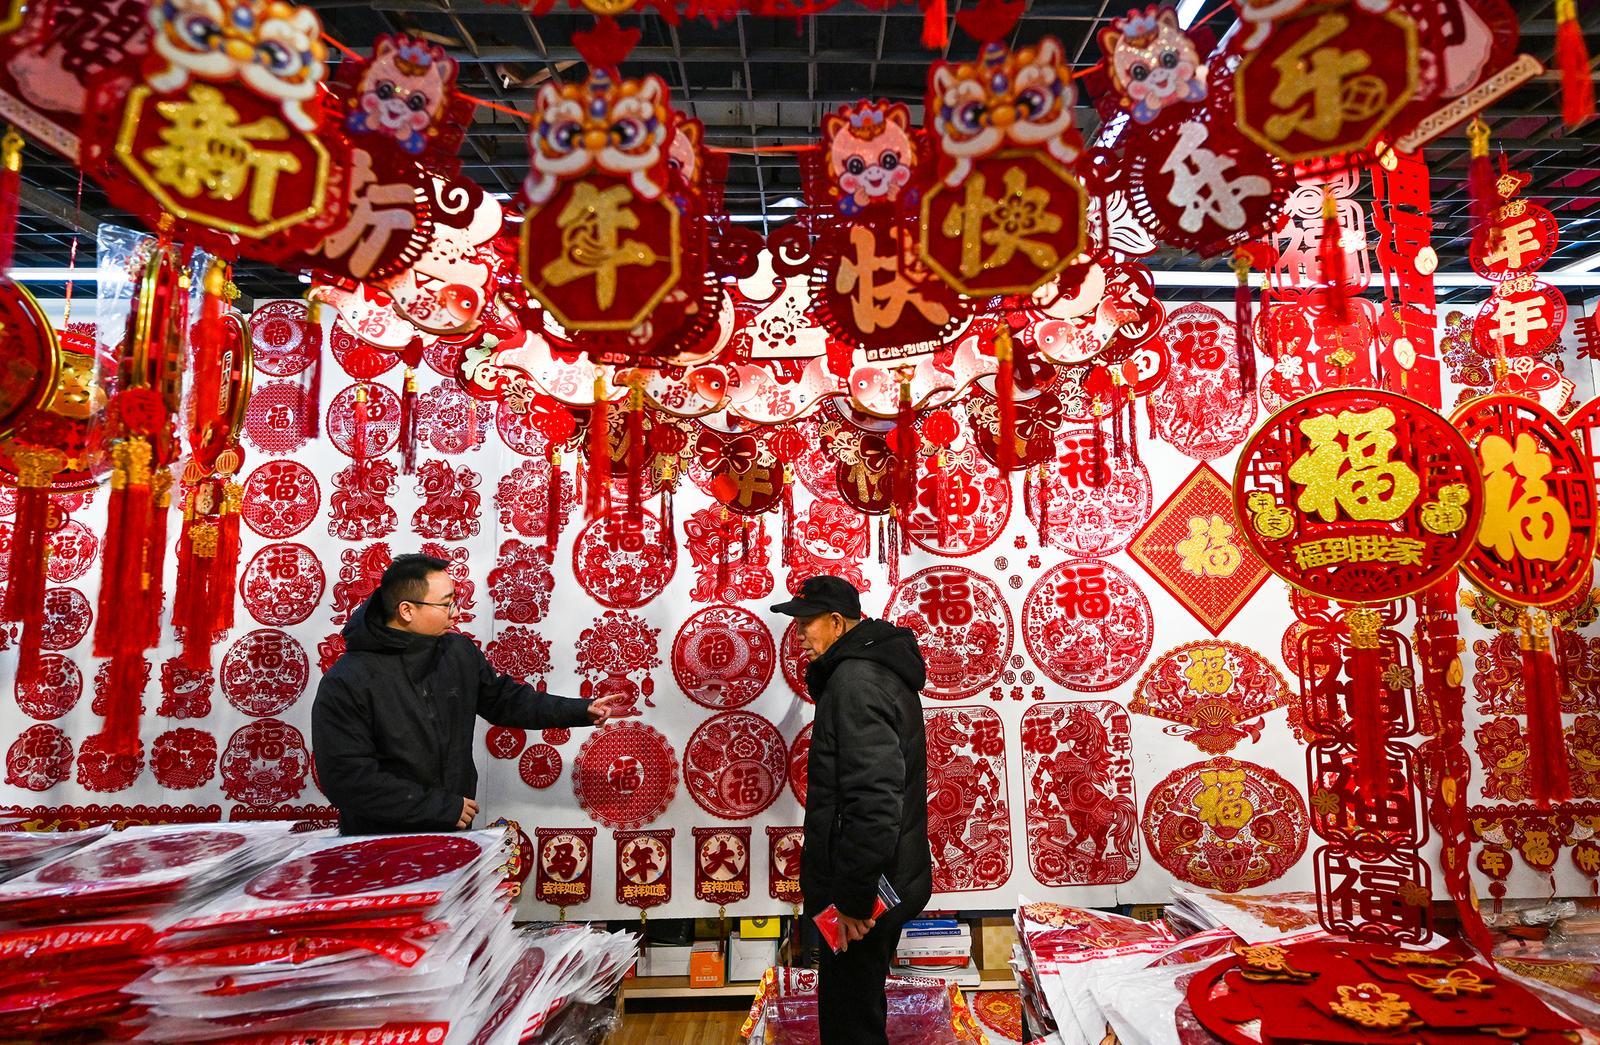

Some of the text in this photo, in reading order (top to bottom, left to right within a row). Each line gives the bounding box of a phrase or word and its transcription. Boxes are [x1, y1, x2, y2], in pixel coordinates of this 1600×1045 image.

[1263, 14, 1388, 141] 乐
[143, 84, 300, 221] 新
[1160, 121, 1271, 233] 乐
[942, 167, 1064, 278] 快
[542, 181, 659, 308] 年
[1483, 218, 1541, 269] 年
[835, 225, 950, 334] 快
[358, 309, 387, 337] 福
[407, 296, 432, 320] 福
[1489, 296, 1548, 345] 年
[264, 319, 292, 346] 福
[1078, 330, 1101, 354] 福
[1172, 320, 1228, 371] 福
[549, 367, 579, 396] 福
[661, 383, 689, 409] 福
[268, 406, 290, 430] 福
[757, 385, 796, 417] 福
[1059, 439, 1112, 488] 福
[1288, 407, 1420, 523] 福
[263, 464, 300, 501] 福
[1477, 433, 1571, 562] 福
[54, 536, 77, 560] 福
[603, 514, 646, 553] 福
[1176, 515, 1242, 577] 福
[1292, 534, 1427, 570] 福到我家
[266, 548, 300, 580] 福
[46, 591, 72, 615] 福
[918, 575, 973, 627] 福
[1055, 567, 1110, 620] 福
[248, 635, 284, 669] 福
[699, 633, 735, 668] 福
[1184, 646, 1233, 695] 福
[245, 720, 286, 760] 福
[970, 719, 1005, 756] 福
[1021, 718, 1057, 754] 福
[1110, 715, 1132, 794] 馬年大吉
[609, 759, 642, 791] 福
[728, 767, 763, 805] 福
[1192, 769, 1253, 829] 福
[547, 843, 577, 880] 马
[625, 846, 658, 883] 年
[704, 841, 738, 875] 大
[1482, 849, 1505, 876] 年
[1577, 846, 1600, 872] 快
[543, 881, 585, 895] 吉祥如意
[623, 884, 667, 898] 吉祥如意
[701, 880, 744, 894] 吉祥如意
[1328, 857, 1419, 928] 福
